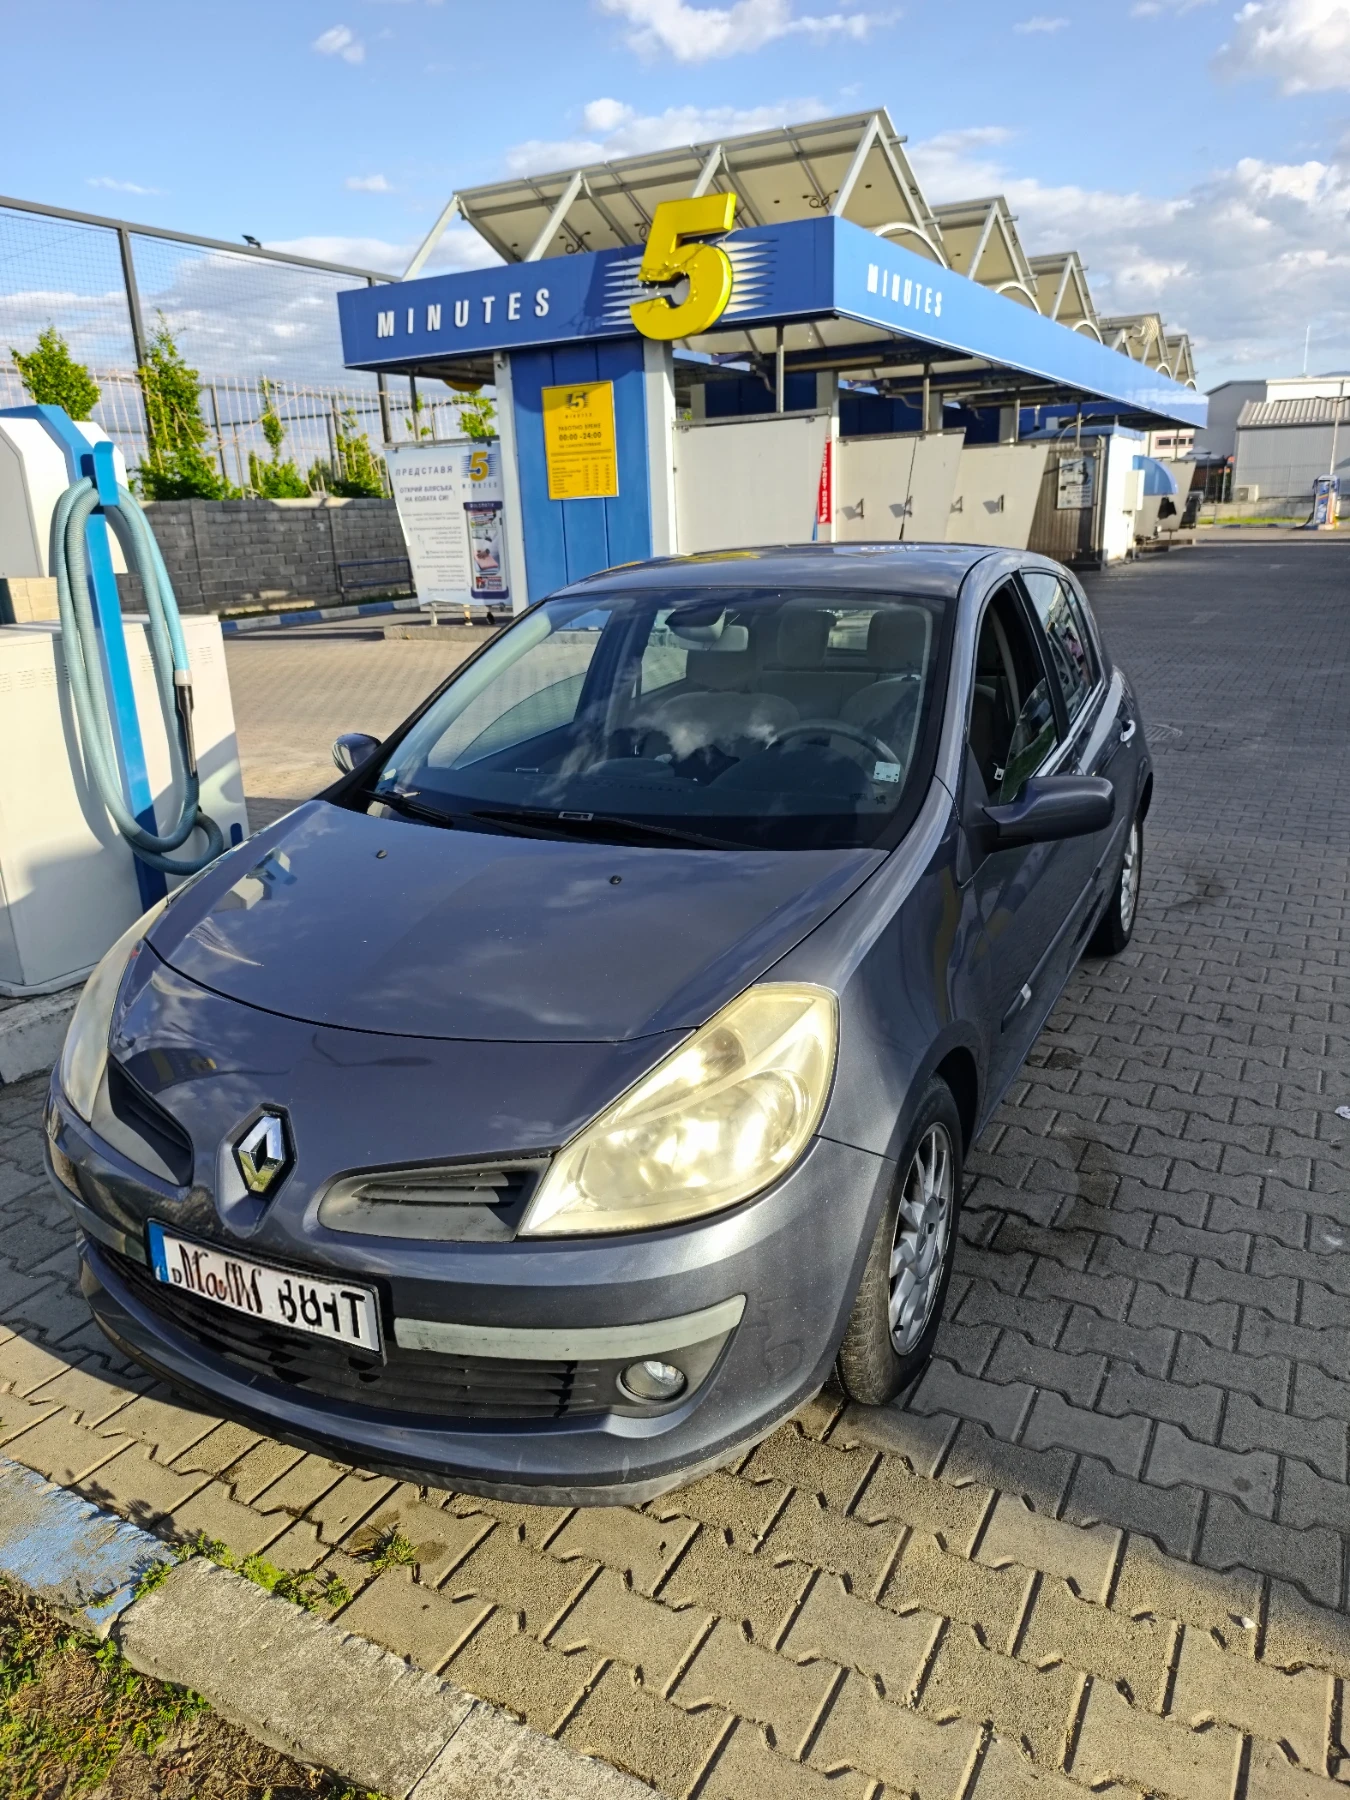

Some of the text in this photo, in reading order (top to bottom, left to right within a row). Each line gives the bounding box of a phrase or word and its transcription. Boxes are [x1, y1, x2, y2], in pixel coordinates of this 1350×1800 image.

[629, 192, 737, 341] 5
[867, 263, 943, 317] MINUTES
[376, 288, 550, 338] MINUTES
[569, 391, 585, 412] 5
[559, 433, 578, 441] 00:00
[395, 465, 453, 477] ПРЕДСТАВЯ
[469, 451, 489, 481] 5
[400, 484, 453, 493] ОТКРИЙ БЛЯСЪКА
